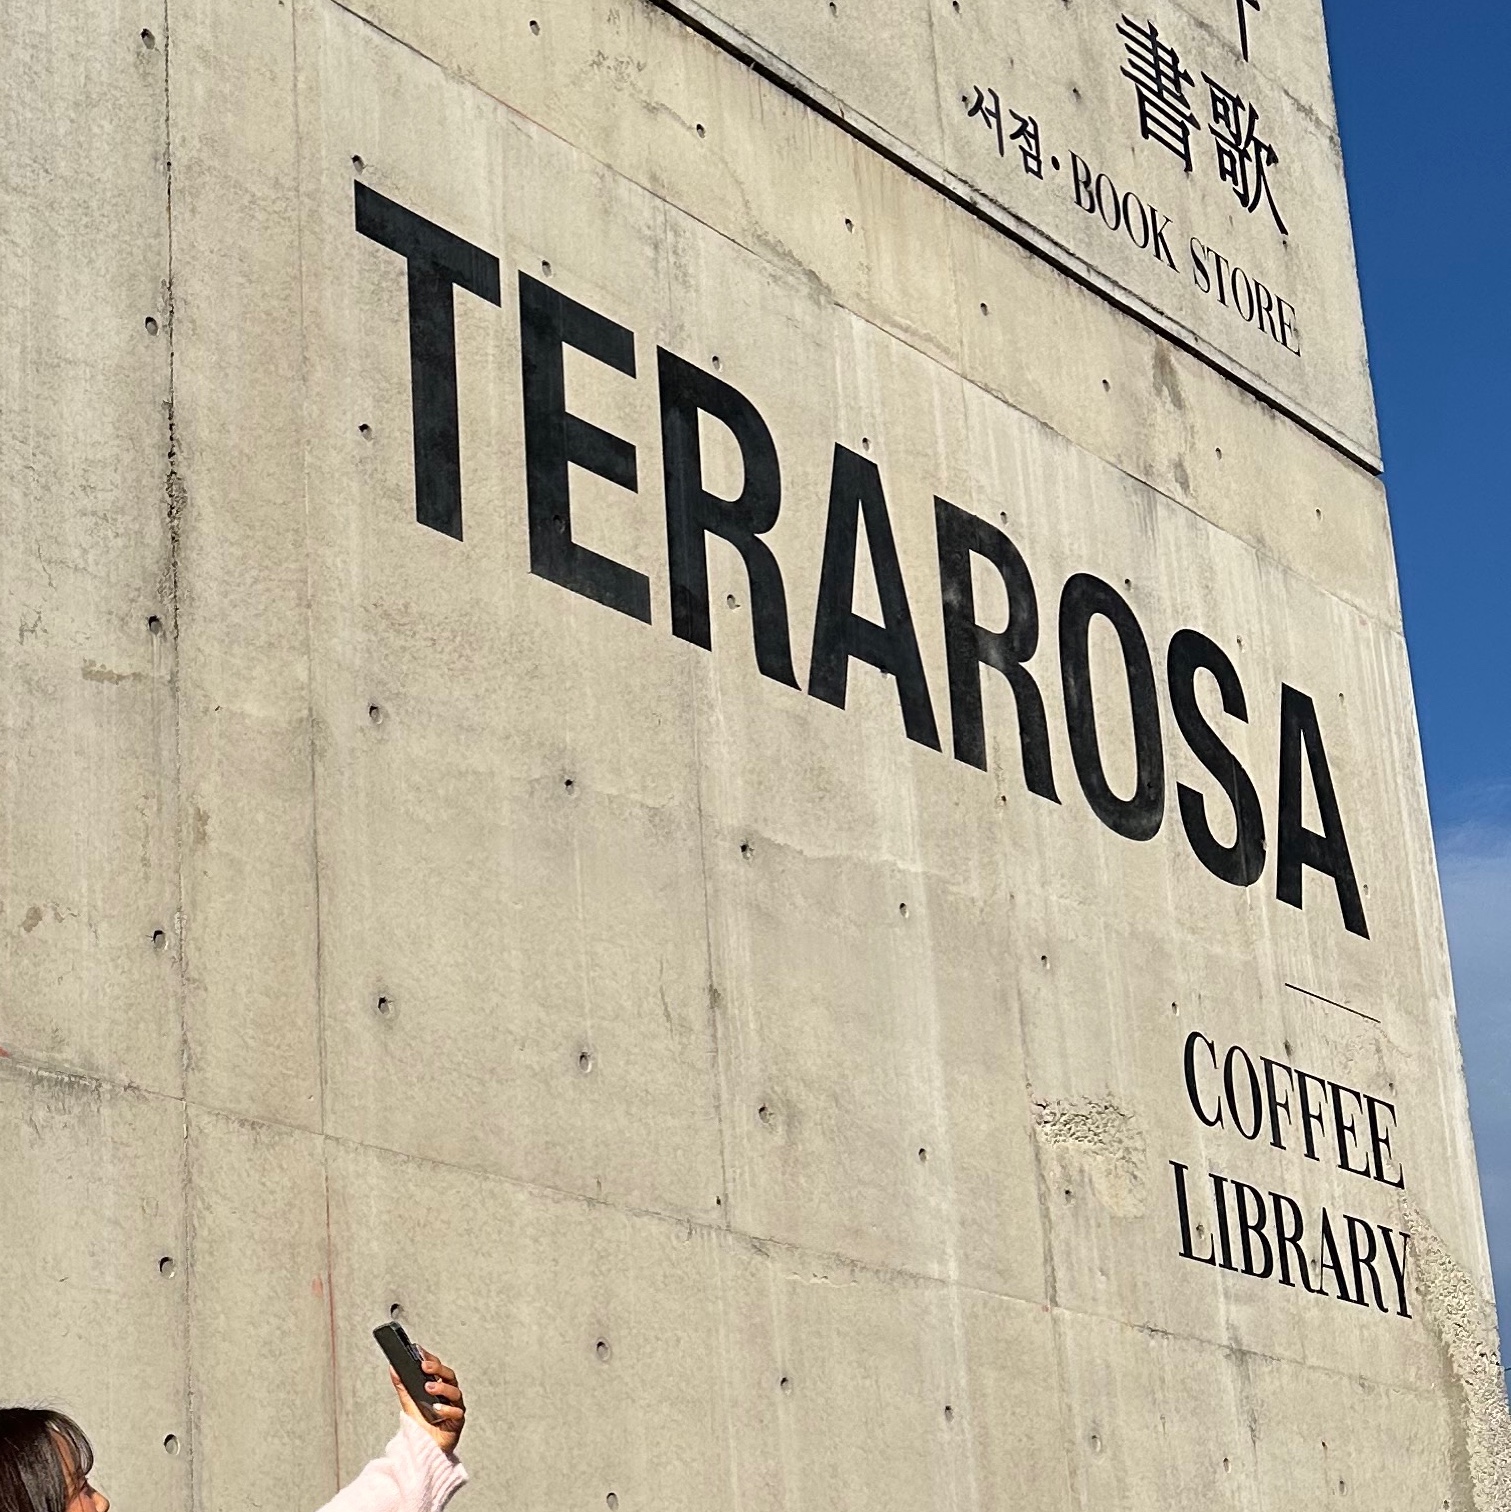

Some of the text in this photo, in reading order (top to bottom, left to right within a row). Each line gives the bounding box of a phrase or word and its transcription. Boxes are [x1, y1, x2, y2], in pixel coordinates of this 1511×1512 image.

[1068, 149, 1181, 274] BOOK
[1189, 236, 1301, 358] STORE
[354, 180, 1370, 940] TERAROSA
[1183, 1031, 1405, 1190] COFFEE
[1168, 1159, 1413, 1320] LIBRARY
